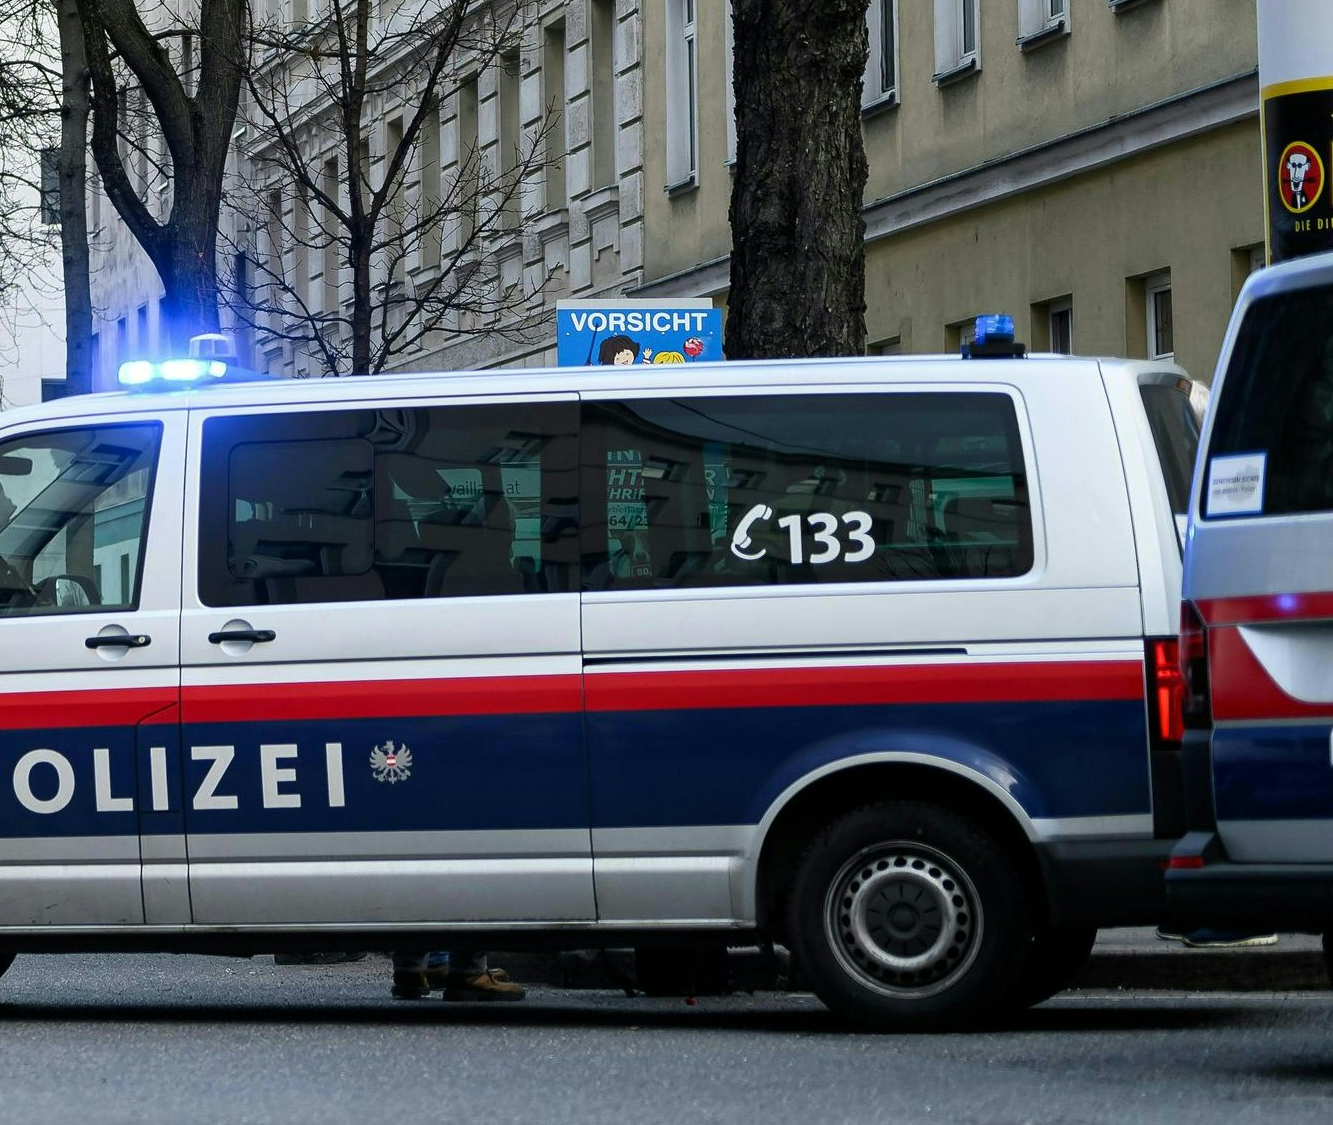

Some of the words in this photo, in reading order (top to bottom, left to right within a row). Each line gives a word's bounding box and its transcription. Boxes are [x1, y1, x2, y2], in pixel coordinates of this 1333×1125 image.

[1295, 219, 1311, 232] DIE
[570, 312, 708, 332] VORSICHT
[778, 511, 876, 564] 133
